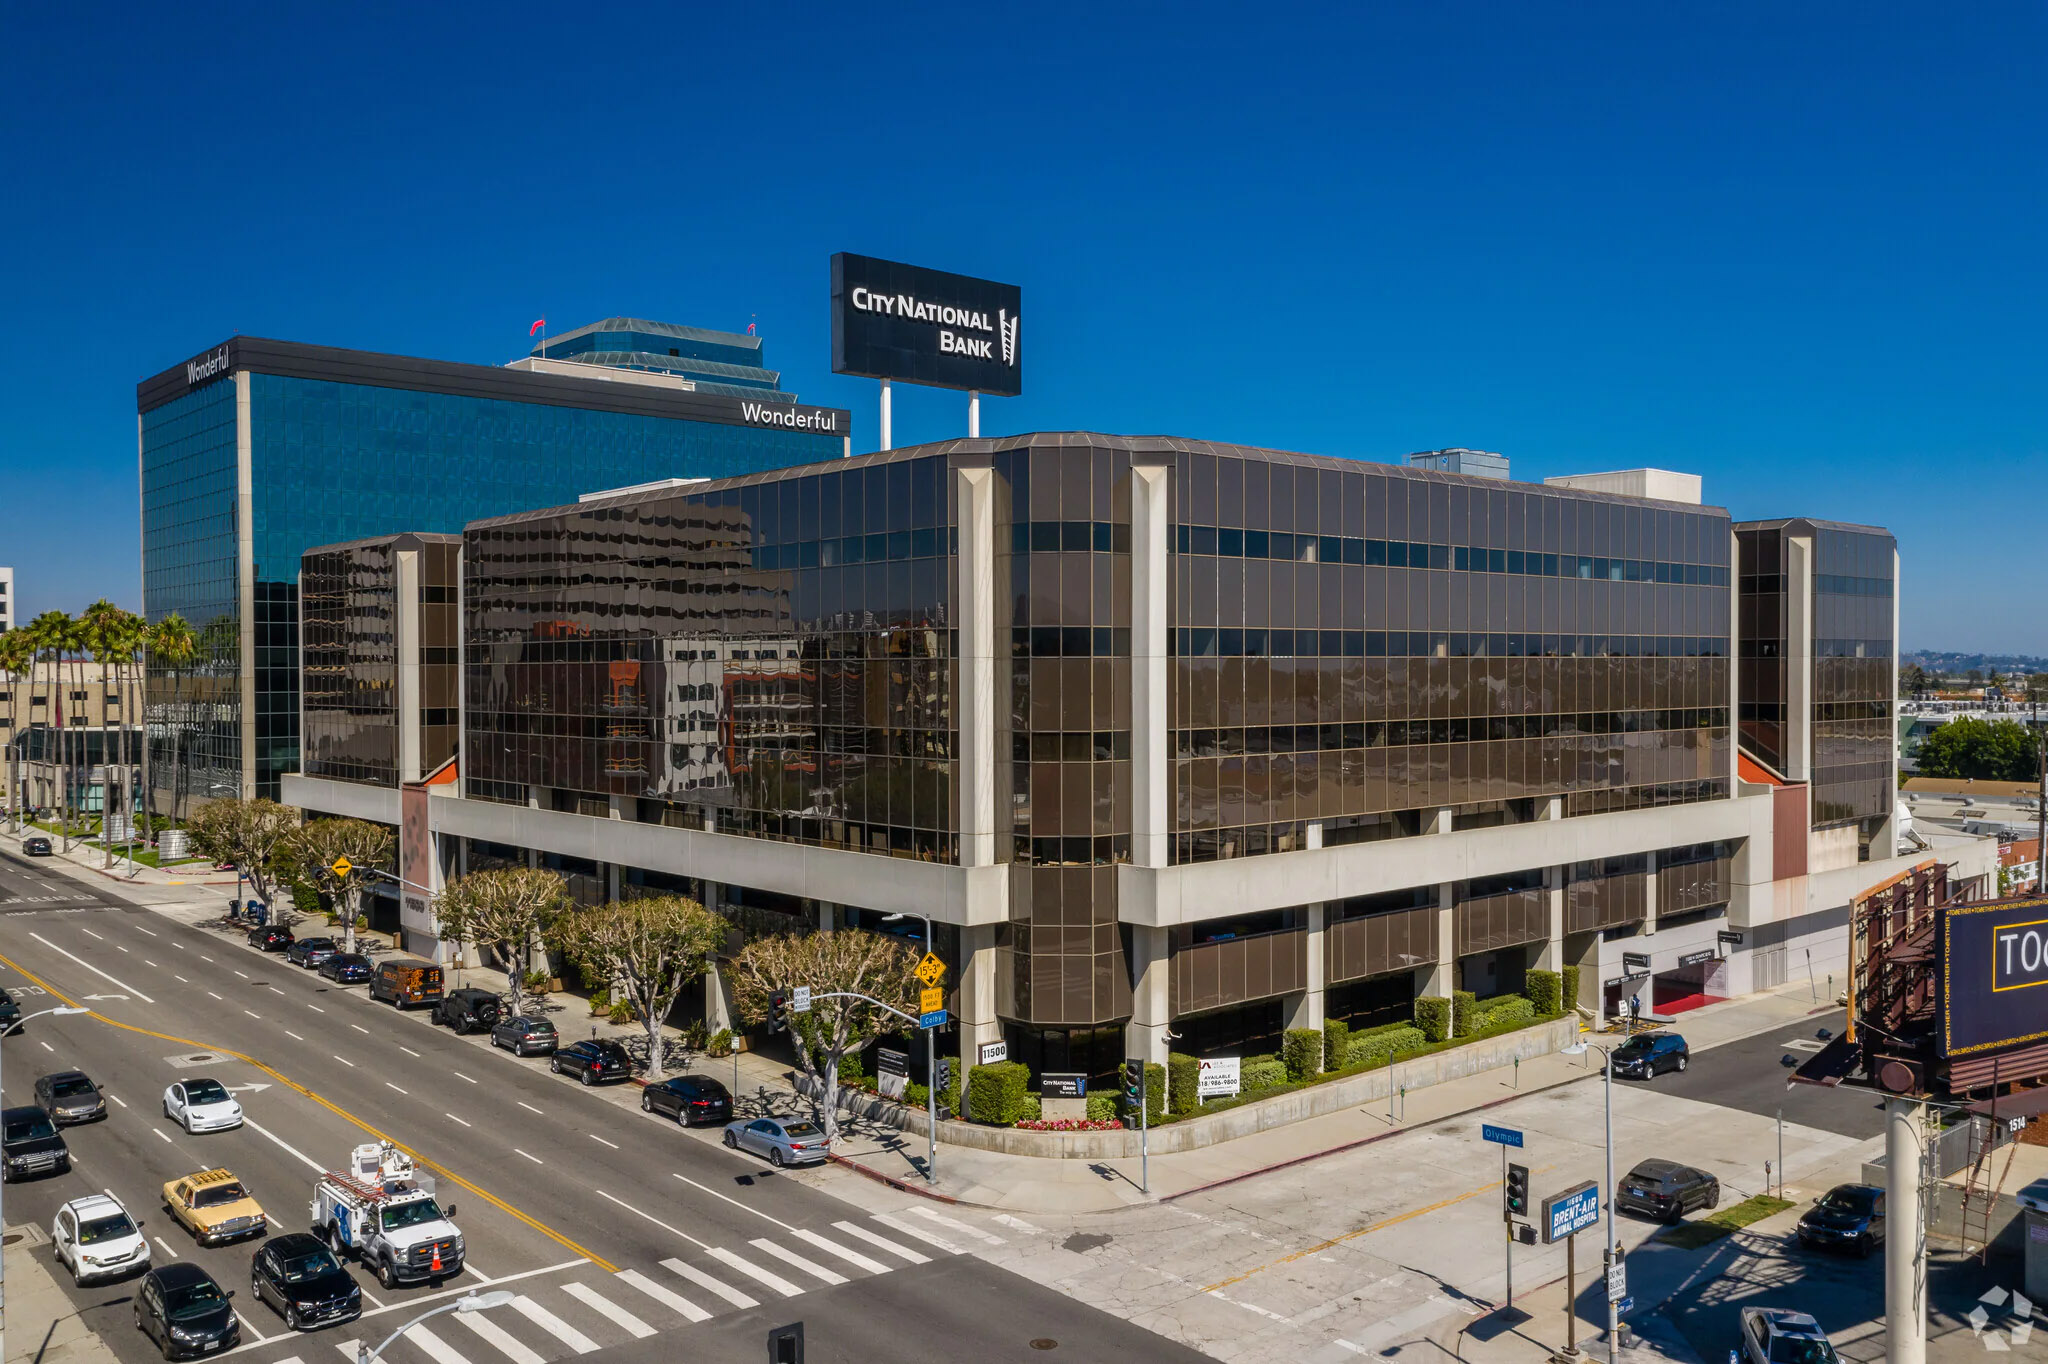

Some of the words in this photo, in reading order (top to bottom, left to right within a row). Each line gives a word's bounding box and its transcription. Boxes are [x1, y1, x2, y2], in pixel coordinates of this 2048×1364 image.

[187, 345, 229, 385] Wonderful
[742, 402, 835, 431] Wonderful
[925, 1015, 942, 1025] Colby
[983, 1045, 1006, 1059] 11500
[2009, 1115, 2026, 1132] 1514
[1485, 1128, 1520, 1144] Olympic
[1553, 1196, 1597, 1227] BRENT-AIR
[1553, 1222, 1573, 1239] ANIMAL
[1573, 1211, 1597, 1229] HOSPITAL
[1610, 1270, 1615, 1280] DO
[1616, 1267, 1624, 1276] NOT
[1610, 1279, 1625, 1290] BLOCK
